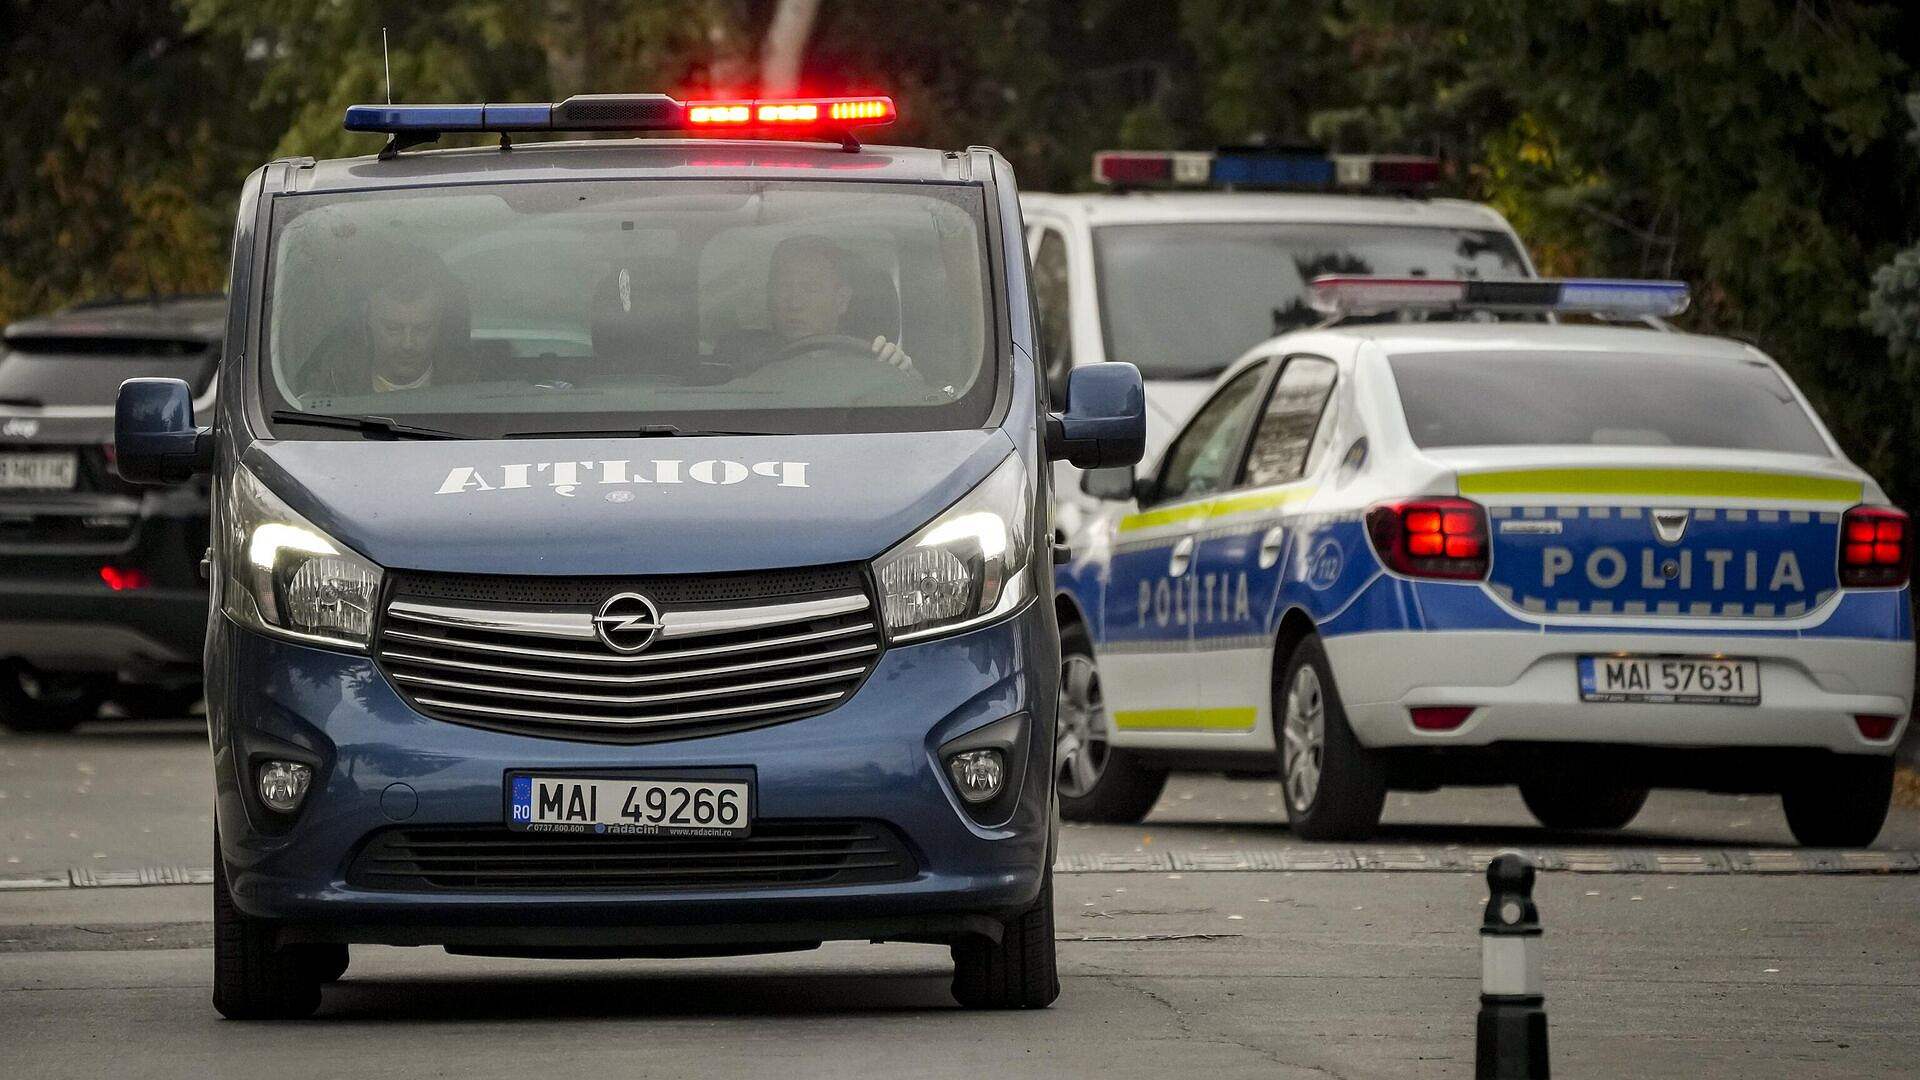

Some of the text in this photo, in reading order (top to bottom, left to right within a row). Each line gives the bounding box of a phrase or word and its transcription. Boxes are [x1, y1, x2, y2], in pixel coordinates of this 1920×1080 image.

[1542, 547, 1805, 591] POLITIA
[1137, 572, 1250, 628] POLITIA
[1606, 662, 1651, 690] MAI
[1662, 663, 1744, 691] 57631
[513, 804, 530, 819] RO
[538, 783, 739, 825] MAI 49266
